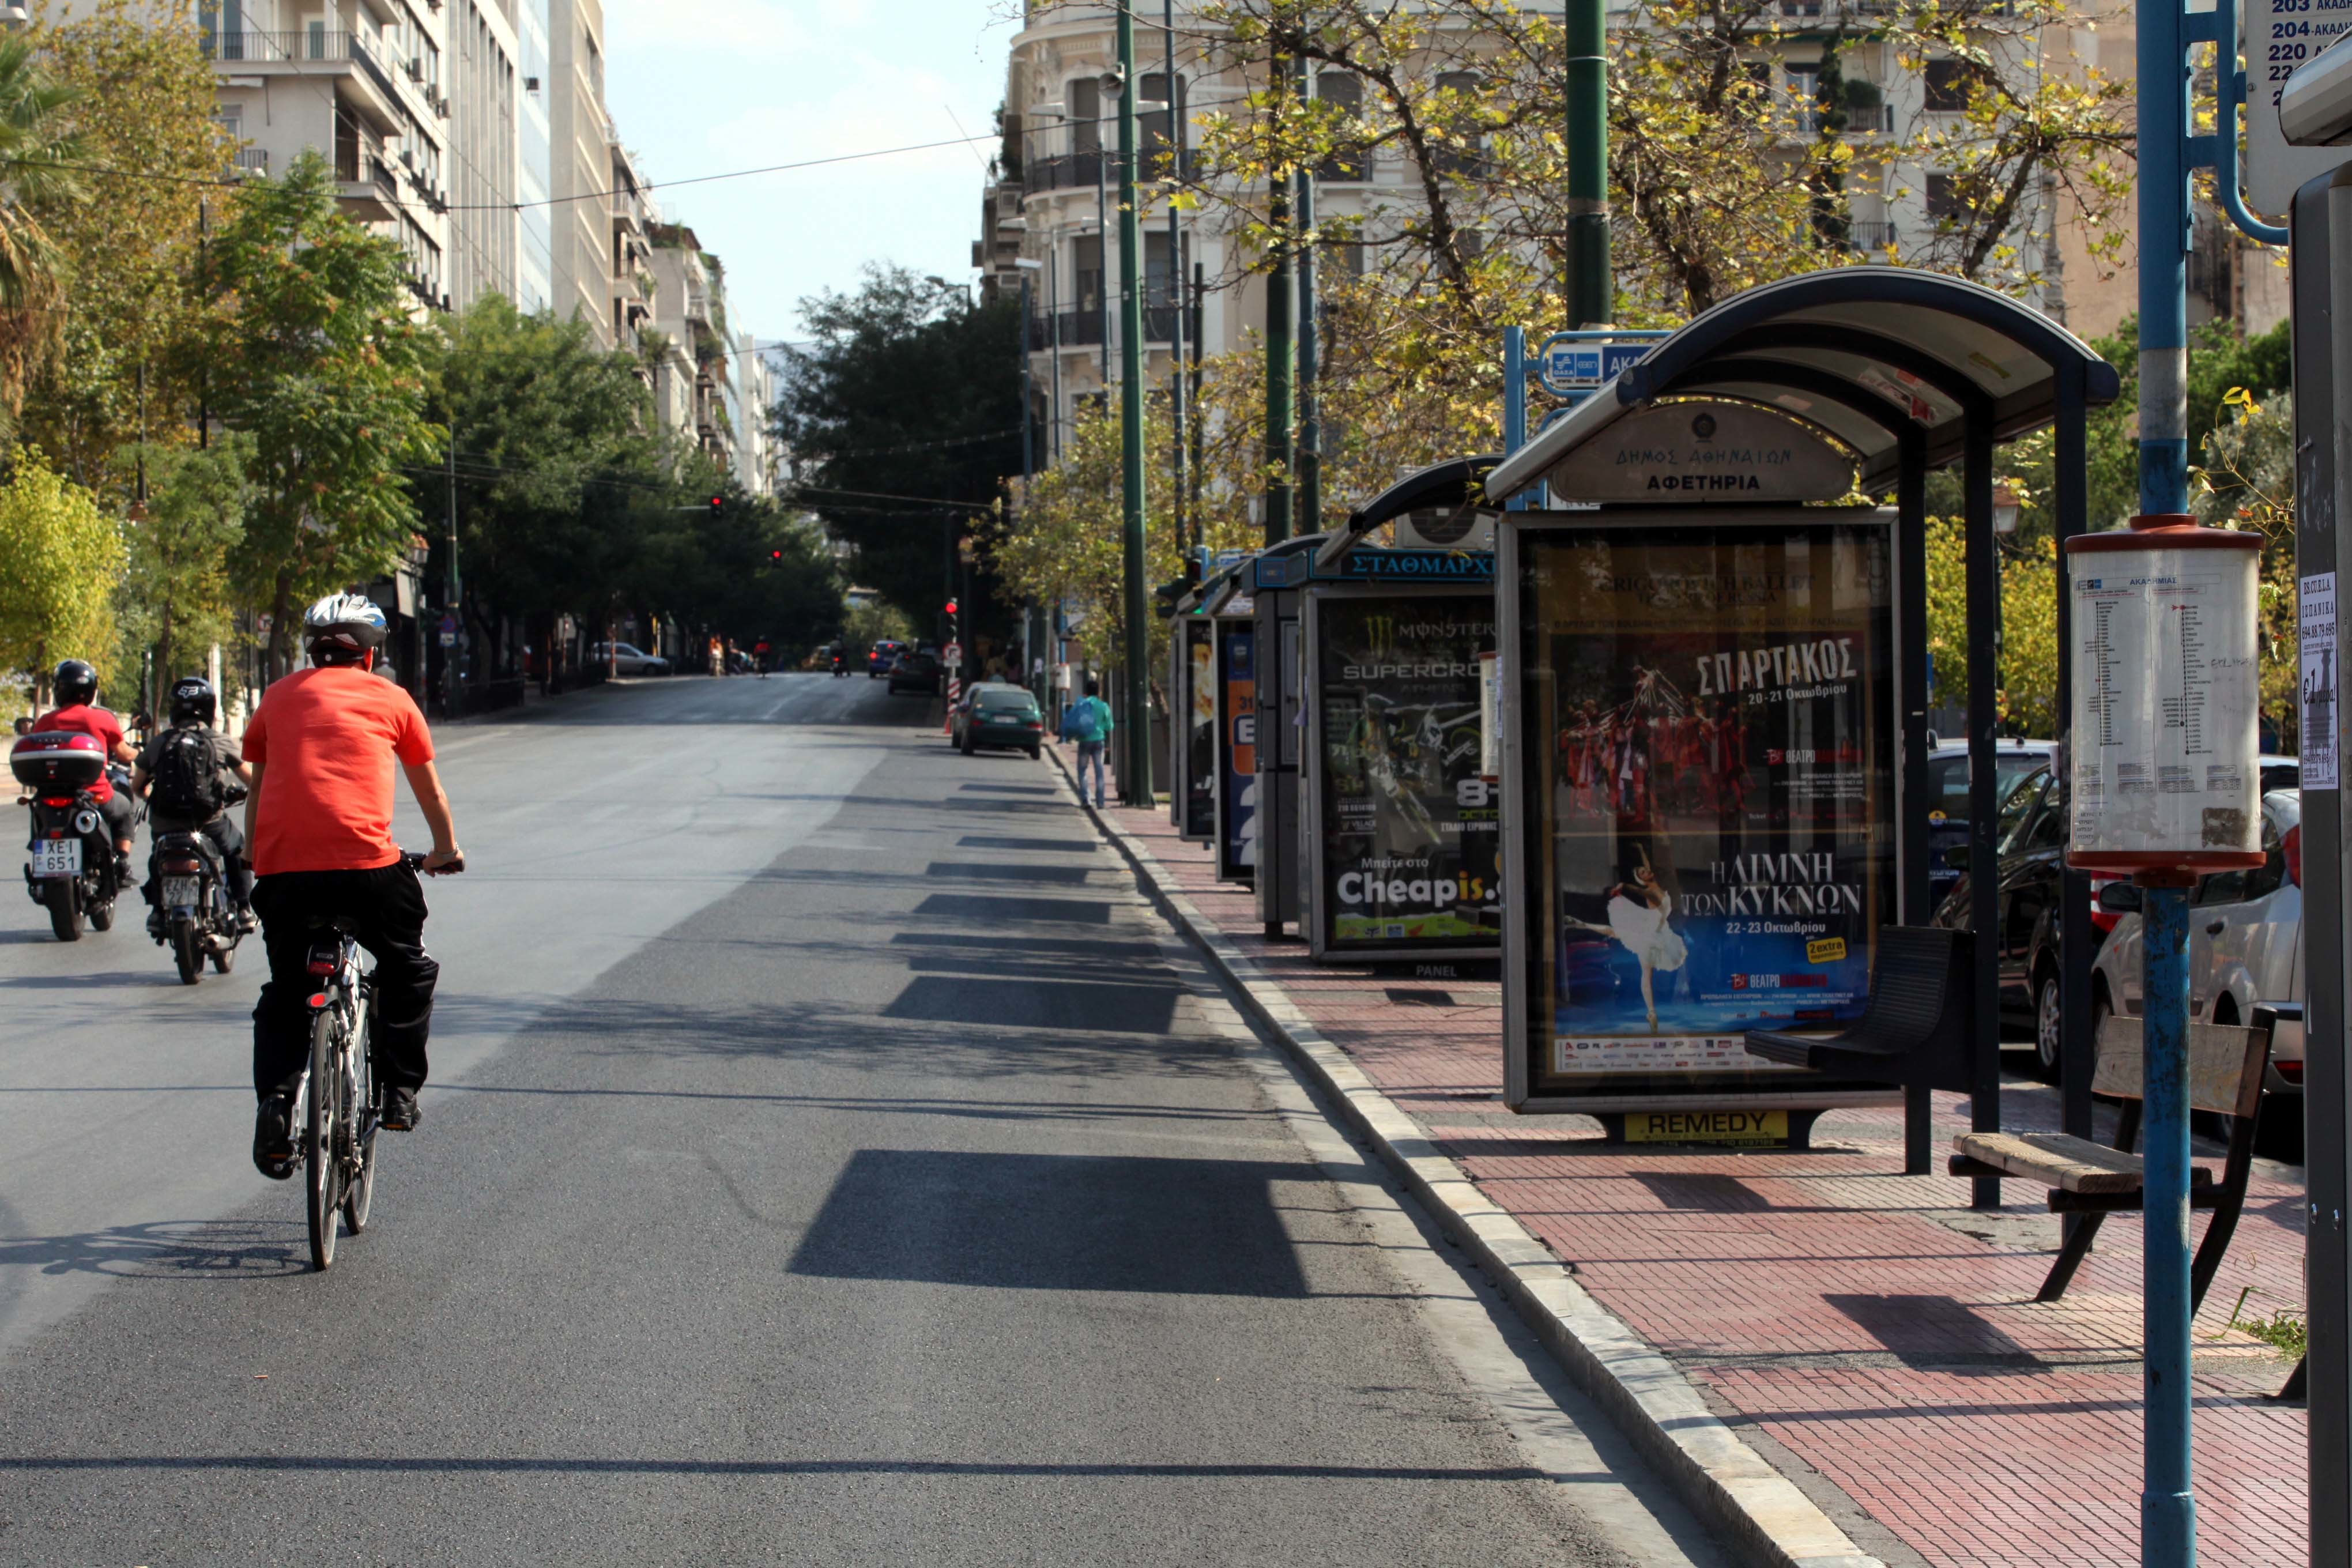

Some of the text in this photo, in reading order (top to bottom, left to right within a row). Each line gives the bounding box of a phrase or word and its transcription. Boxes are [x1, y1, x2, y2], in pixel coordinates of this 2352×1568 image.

[2272, 0, 2310, 13] 203
[2272, 21, 2310, 39] 204
[2268, 43, 2306, 61] 220
[1615, 449, 1791, 465] ΔΗΜΟΣ ΑΘΗΝΑΙΩΝ
[1647, 476, 1761, 490] ΑΦΕΤΗΡΙΑ
[2130, 578, 2177, 586] ΑΚΑΔΗΜΙΑΣ
[1399, 621, 1496, 639] MONSTER
[1697, 638, 1857, 696] ΣΠΑΡΤΑΚΟΣ
[1786, 684, 1848, 700] Οκτωβρίου
[47, 857, 74, 870] 651
[1361, 857, 1429, 869] Μπείτε στο
[1712, 853, 1834, 884] Η ΛΙΜΝΗ
[1681, 884, 1861, 916] ΤΩΝ ΚΥΚΝΩΝ
[1764, 921, 1826, 935] Οκτωβρίου
[1810, 941, 1842, 953] 2 extra
[1416, 965, 1457, 977] PANEL
[1750, 974, 1780, 988] ΘΕΑΤΡΟ
[1648, 1113, 1767, 1133] REMEDY
